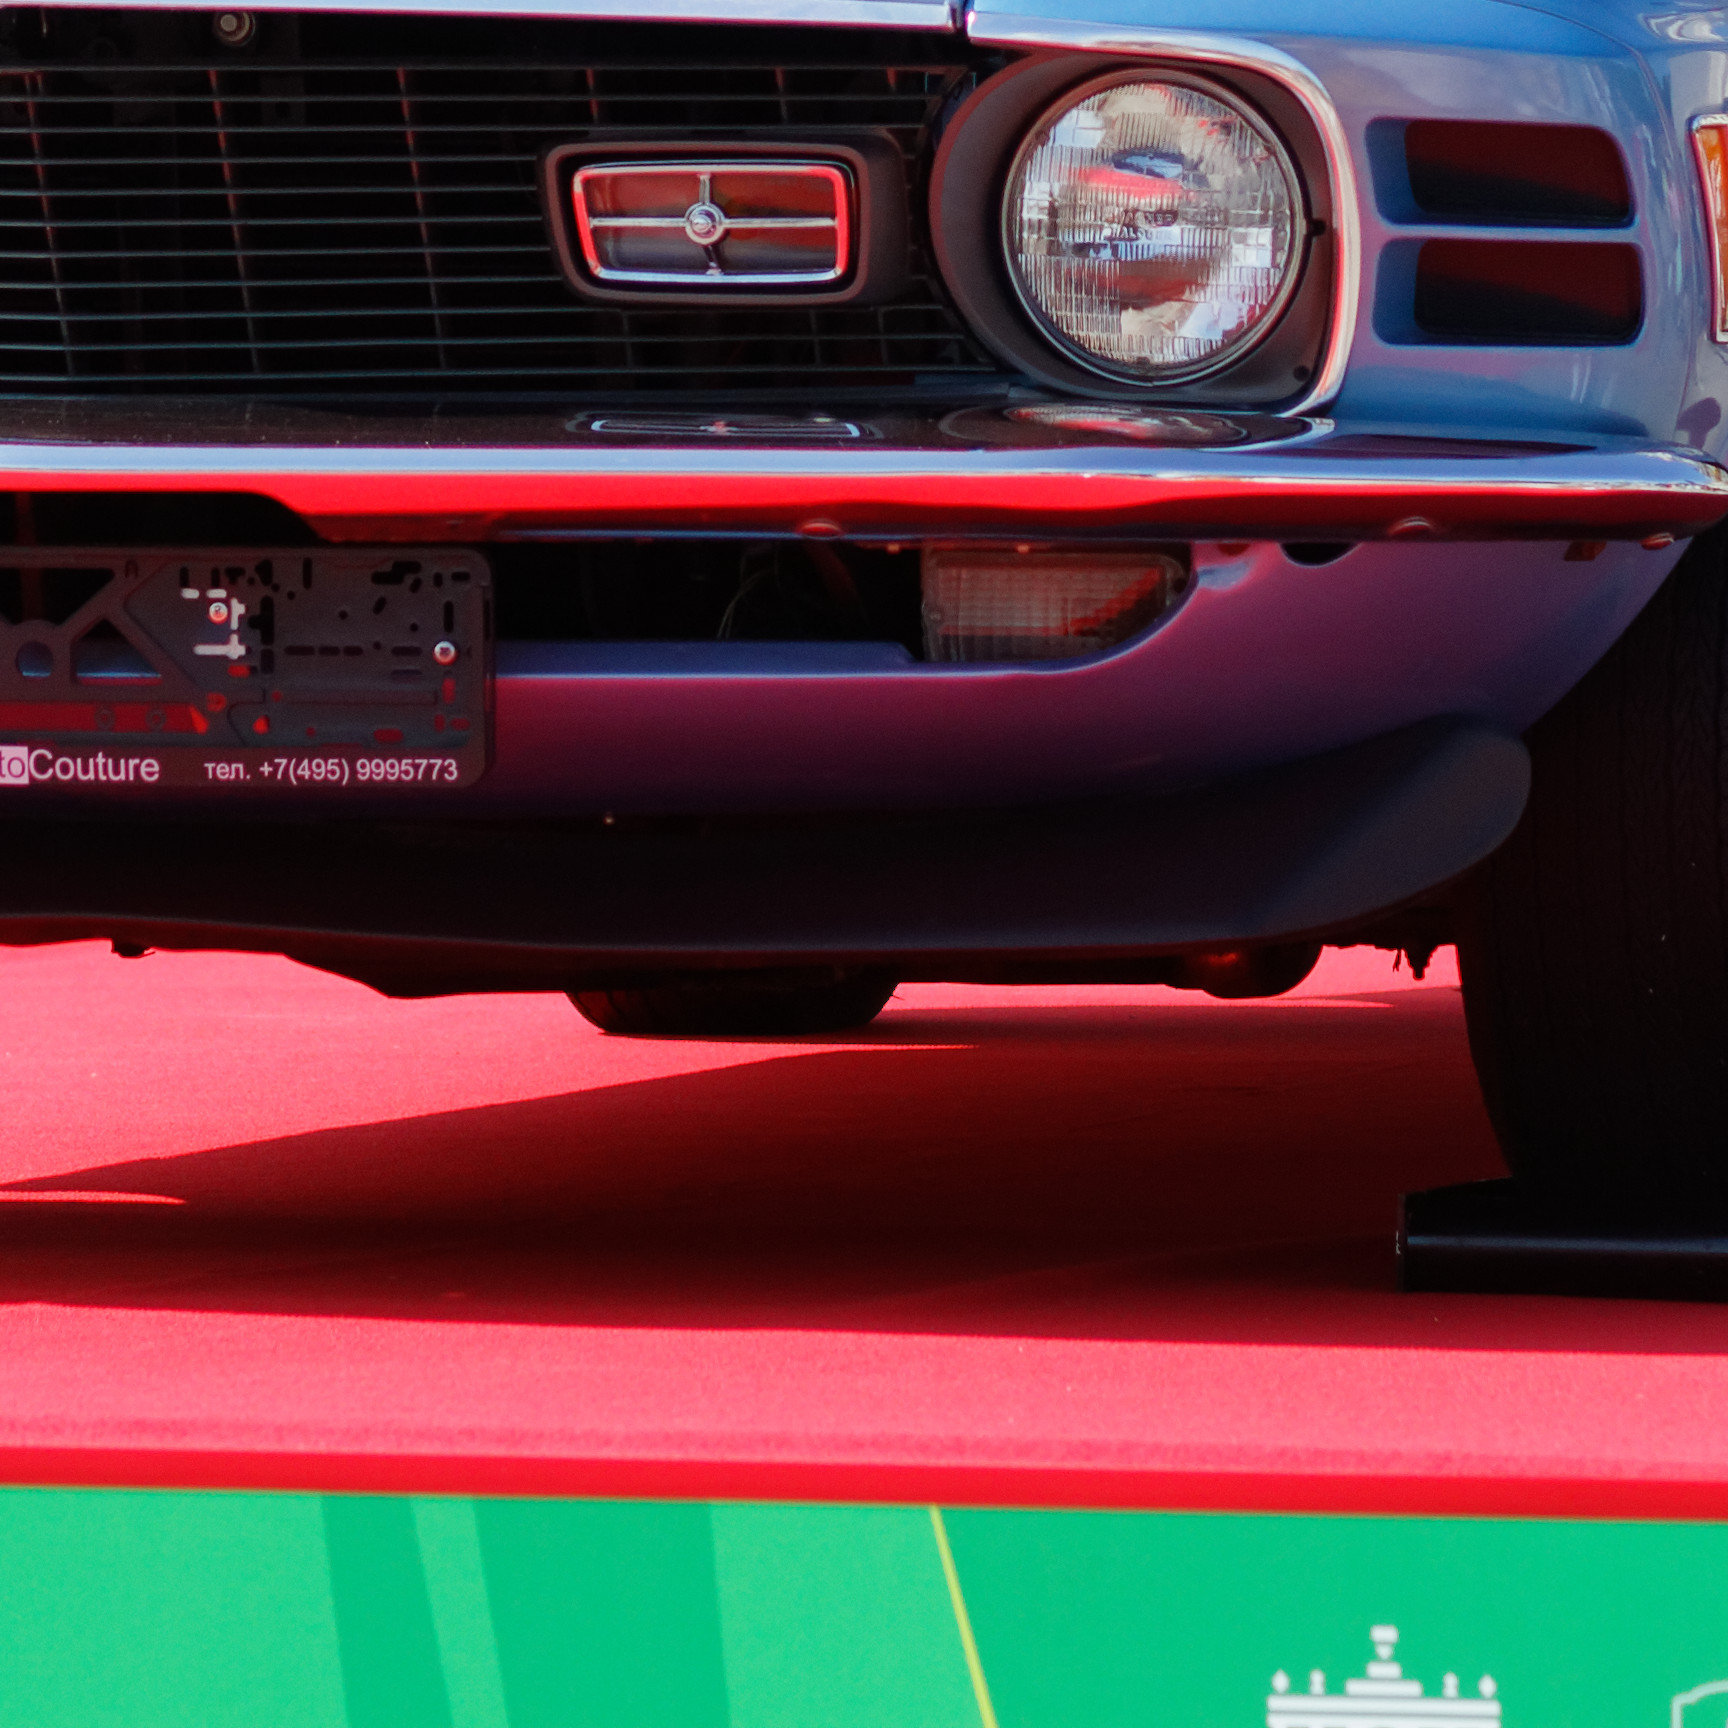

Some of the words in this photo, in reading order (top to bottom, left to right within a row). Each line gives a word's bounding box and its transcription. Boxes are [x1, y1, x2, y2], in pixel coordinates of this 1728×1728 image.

[204, 762, 251, 780] тел.
[259, 758, 350, 786] +7(495)
[356, 758, 458, 781] 9995773
